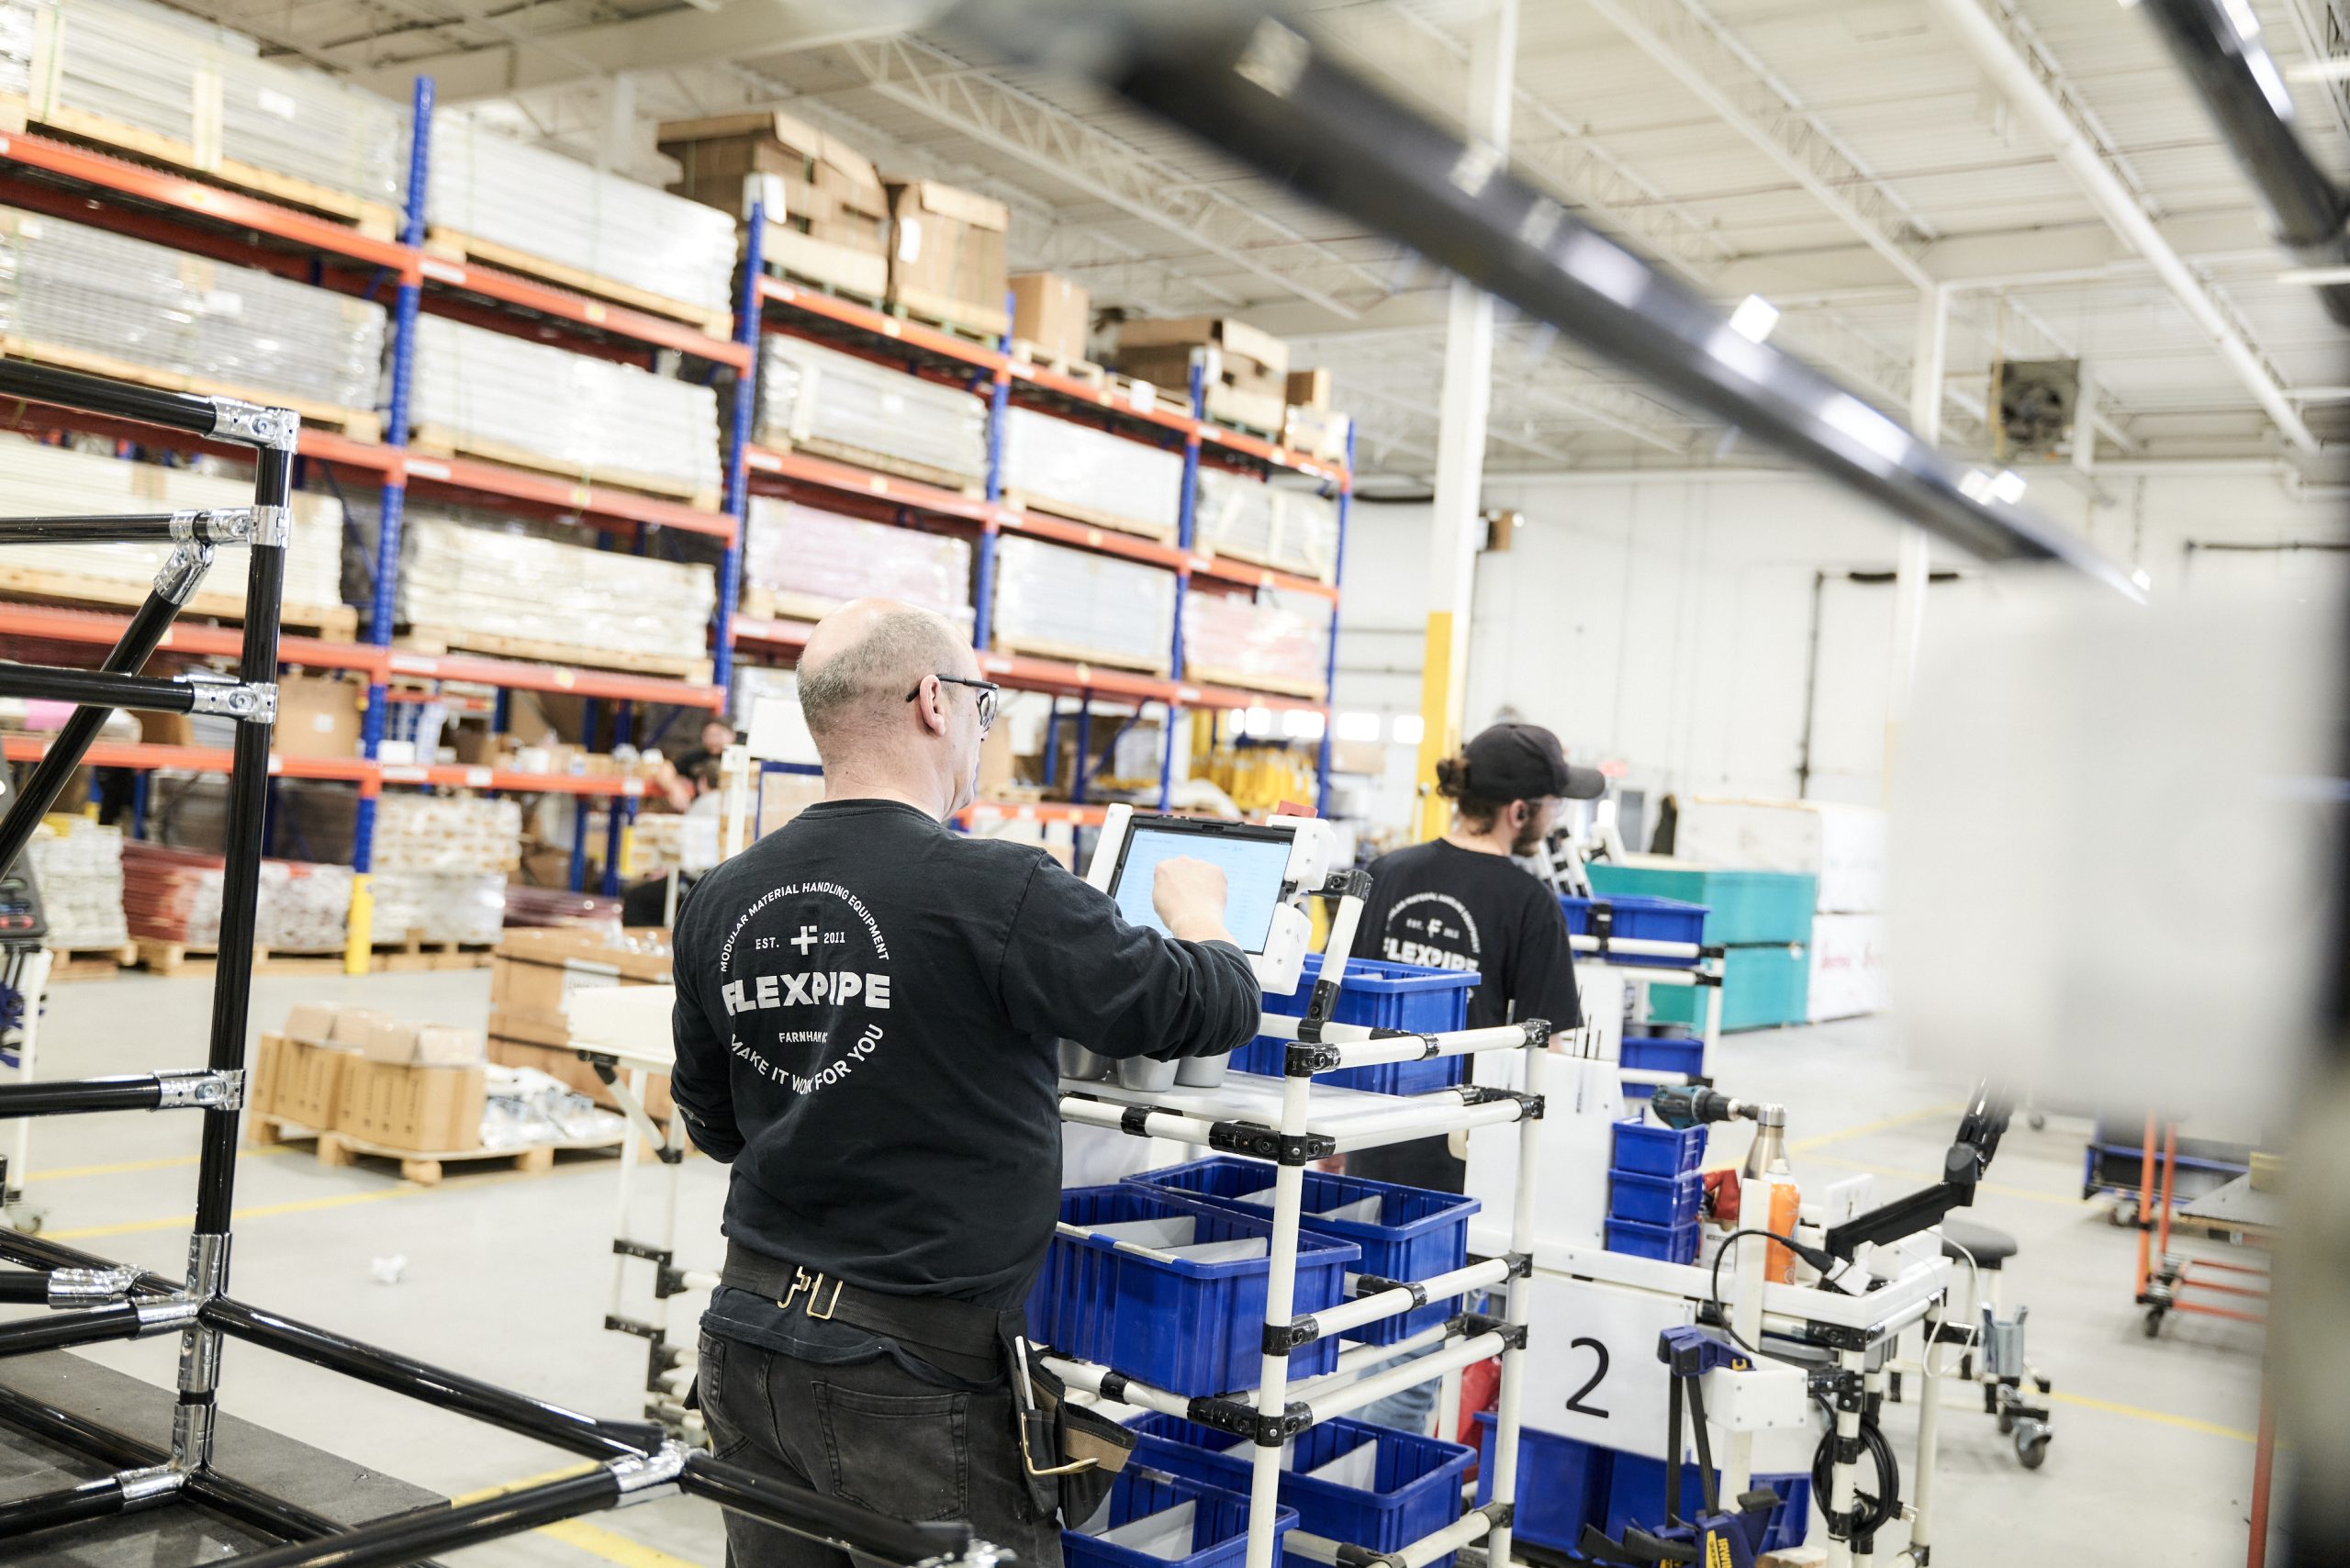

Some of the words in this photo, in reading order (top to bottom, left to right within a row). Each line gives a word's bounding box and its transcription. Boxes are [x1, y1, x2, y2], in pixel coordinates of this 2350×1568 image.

[721, 913, 749, 972] MODULAR
[747, 883, 800, 917] MATERIAL
[801, 881, 850, 901] HANDLING
[847, 894, 890, 960] EQUIPMENT
[755, 936, 780, 950] EST.
[823, 931, 845, 945] 2011
[722, 971, 890, 1016] FLEXPIPE
[731, 1033, 770, 1076] MAKE
[771, 1066, 789, 1085] IT
[814, 1059, 852, 1091] FOR
[846, 1023, 884, 1062] YOU
[1566, 1337, 1609, 1419] 2
